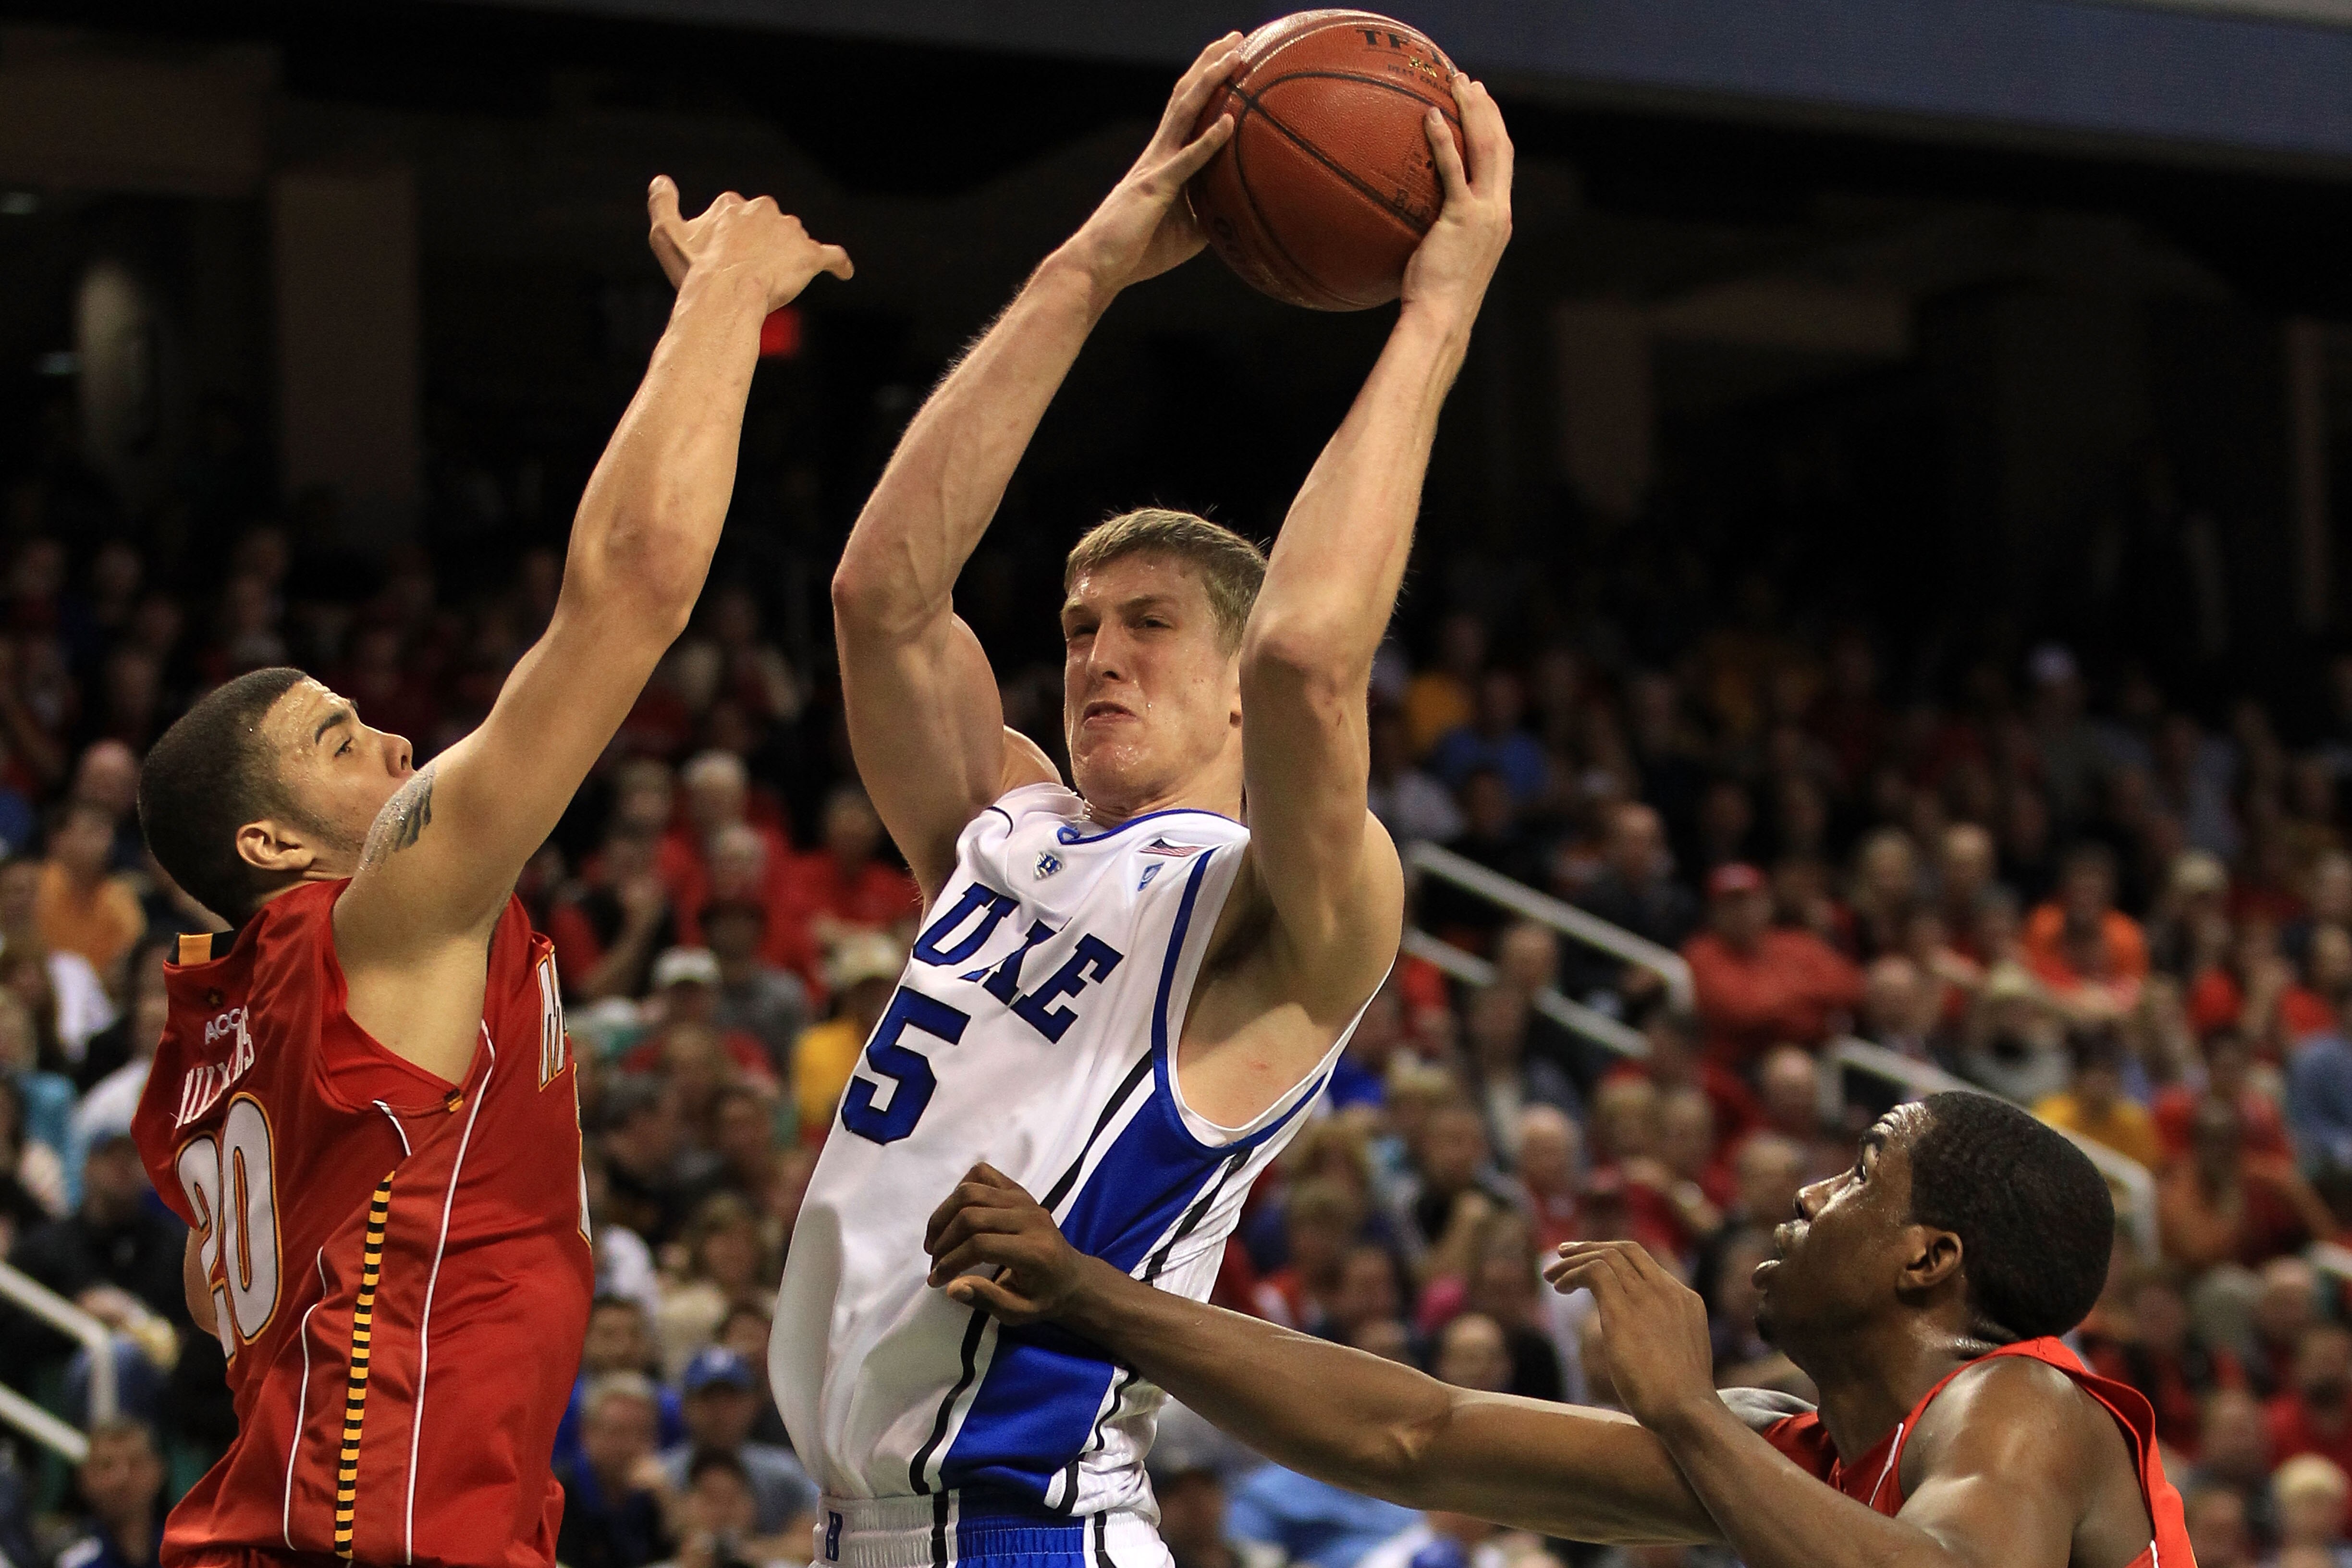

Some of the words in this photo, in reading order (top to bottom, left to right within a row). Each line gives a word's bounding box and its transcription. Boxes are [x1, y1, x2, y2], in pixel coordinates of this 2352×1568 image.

[205, 1008, 241, 1045] ACC
[841, 985, 971, 1145] 5
[174, 1091, 283, 1369] 20
